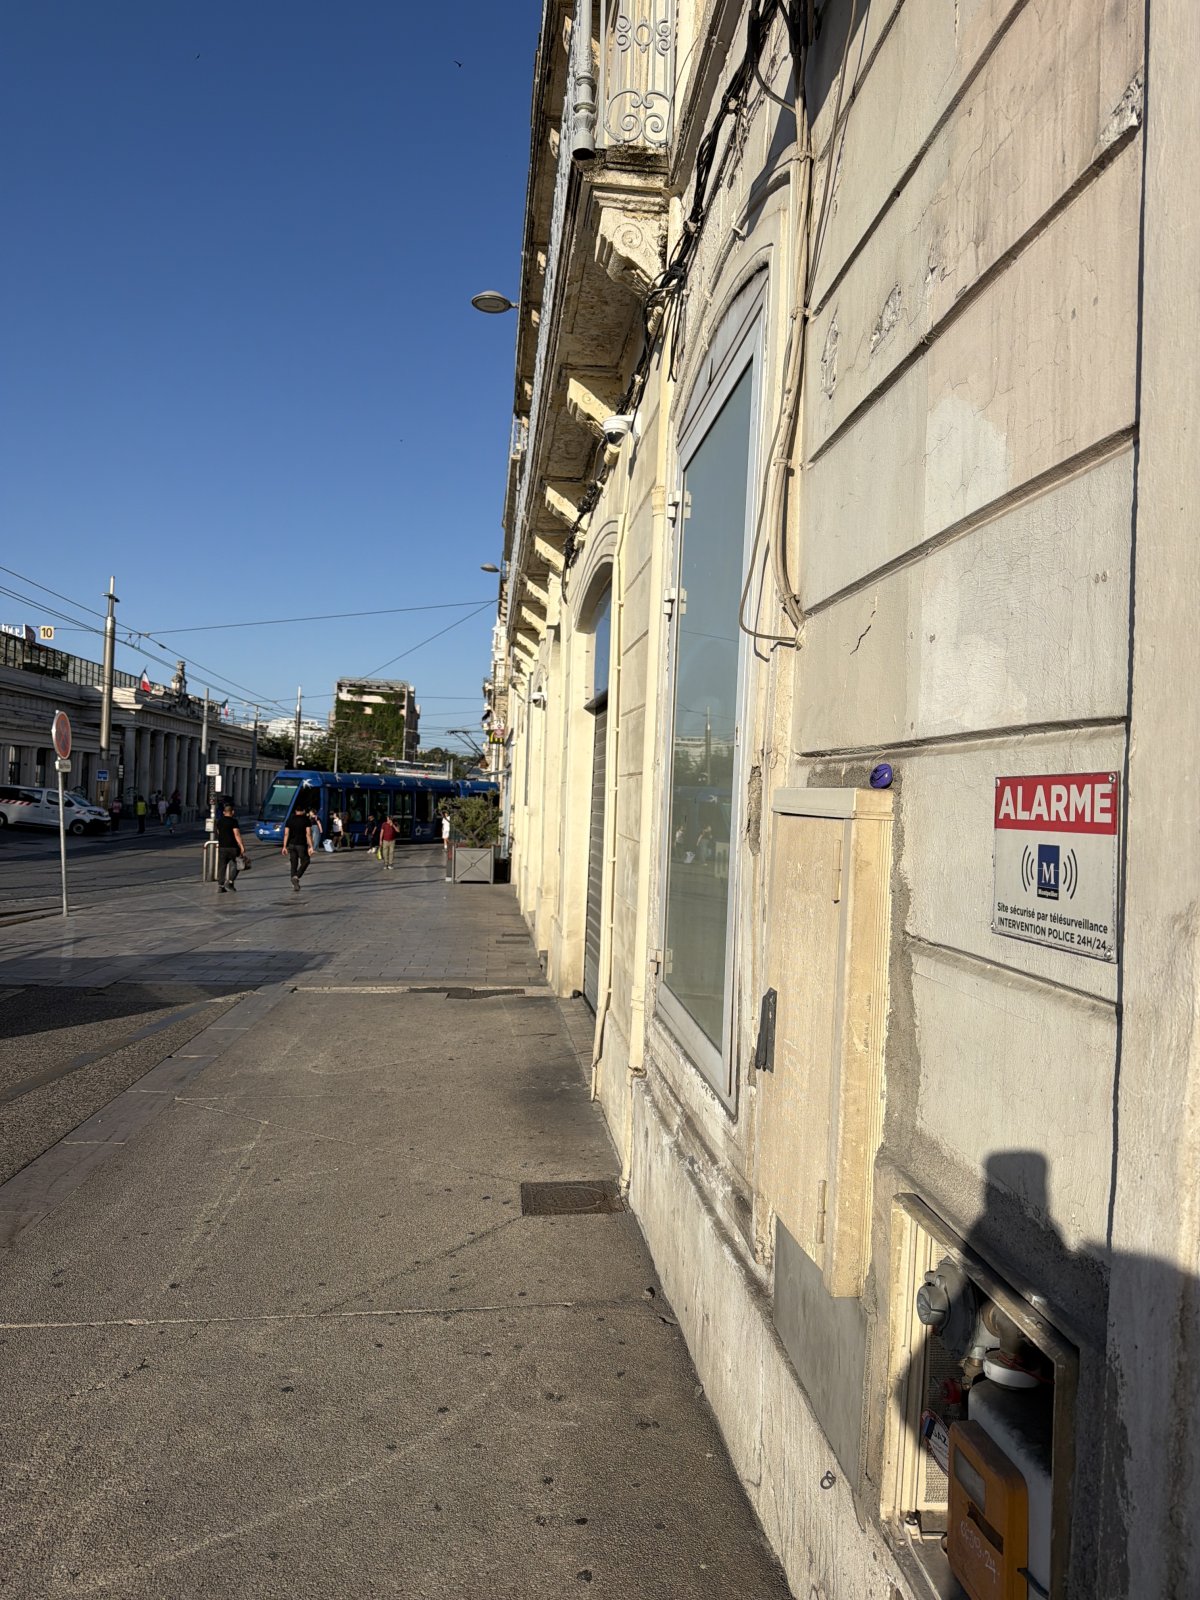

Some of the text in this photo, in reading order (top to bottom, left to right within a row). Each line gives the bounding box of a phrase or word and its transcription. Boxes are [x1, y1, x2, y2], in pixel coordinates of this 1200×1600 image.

[41, 627, 53, 638] 10
[998, 783, 1113, 824] ALARME
[1041, 861, 1056, 885] M
[997, 901, 1108, 934] Site sécurisé par télésurveillance
[997, 916, 1107, 951] INTERVENTION POLICE 24H/24
